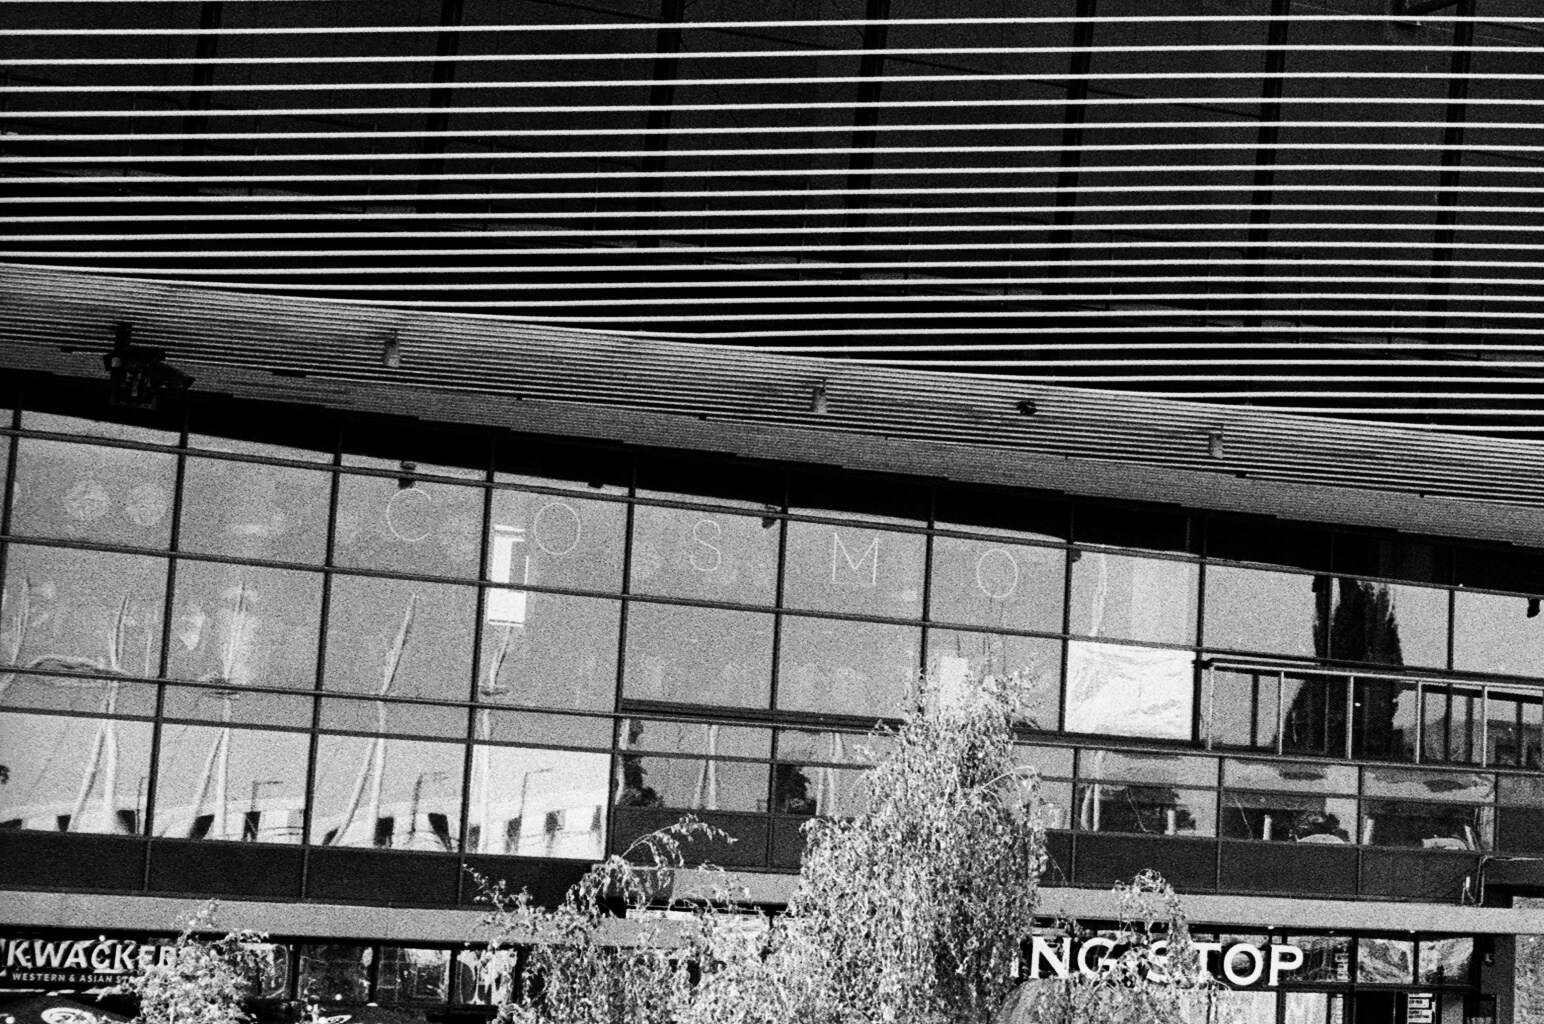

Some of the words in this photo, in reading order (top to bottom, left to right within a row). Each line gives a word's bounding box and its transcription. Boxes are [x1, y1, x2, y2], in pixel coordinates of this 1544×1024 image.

[385, 487, 1019, 600] COSMO
[12, 972, 65, 982] WESTERN
[79, 974, 113, 984] ASIAN
